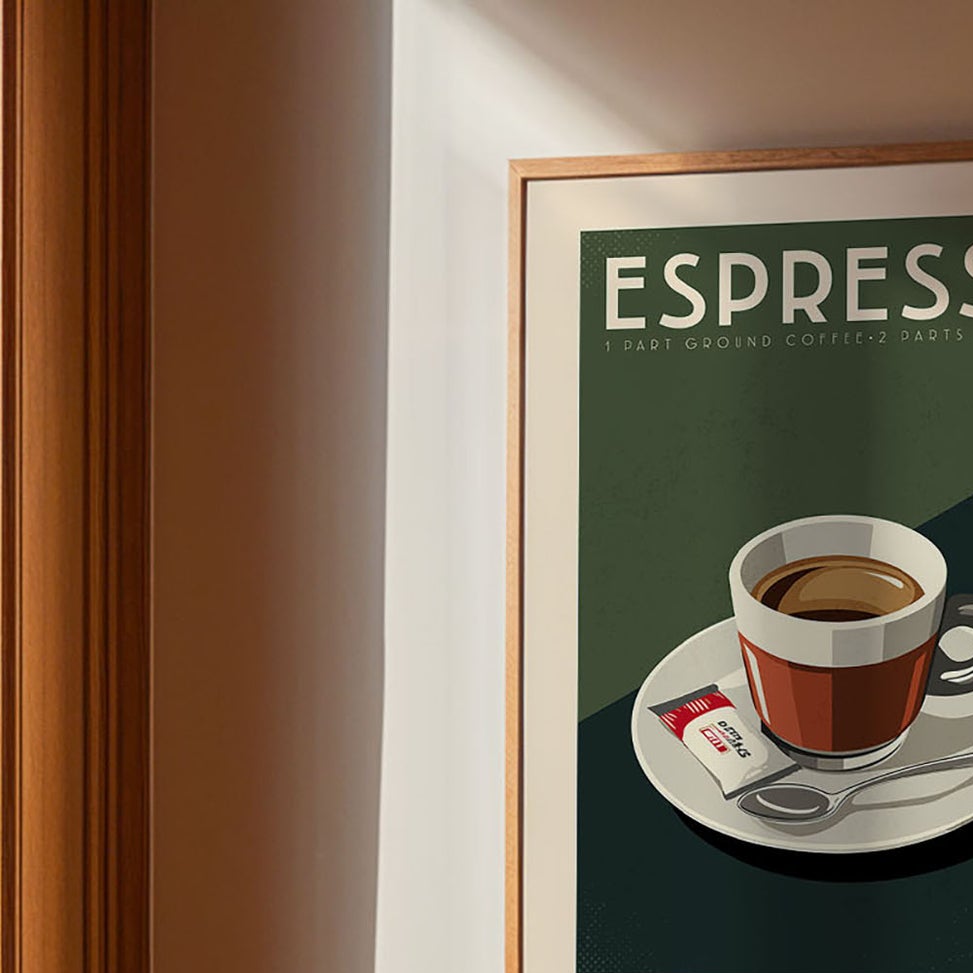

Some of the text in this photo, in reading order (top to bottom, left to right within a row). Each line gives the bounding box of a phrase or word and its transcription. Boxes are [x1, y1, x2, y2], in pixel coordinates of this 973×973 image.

[605, 340, 610, 353] 1
[624, 338, 671, 352] PART
[685, 334, 772, 350] GROUND
[900, 328, 964, 342] PARTS
